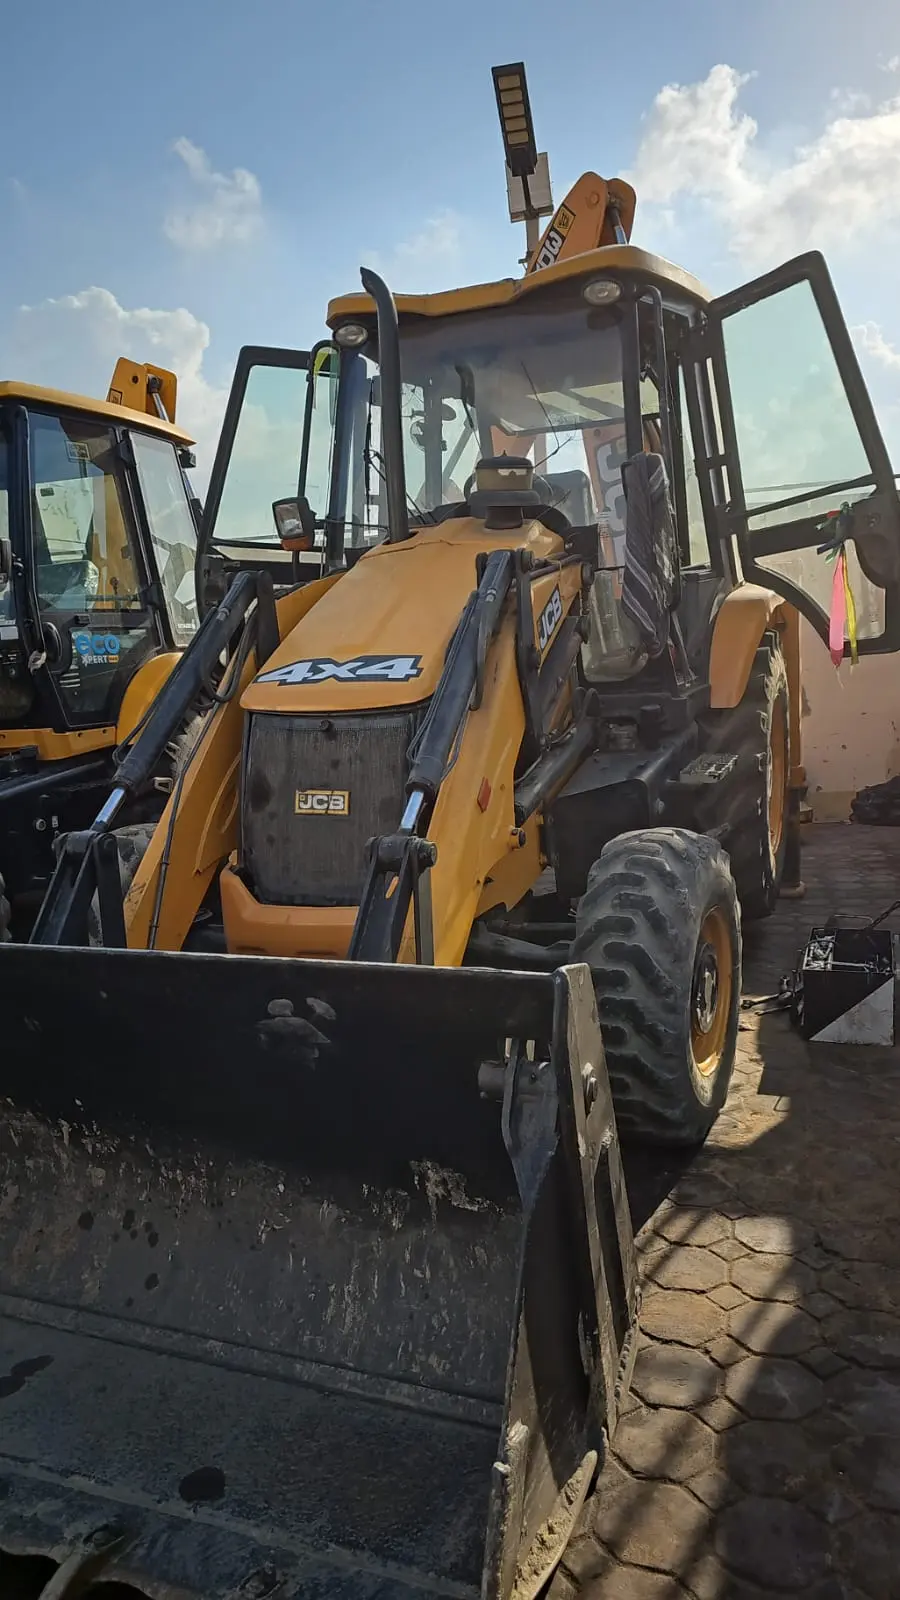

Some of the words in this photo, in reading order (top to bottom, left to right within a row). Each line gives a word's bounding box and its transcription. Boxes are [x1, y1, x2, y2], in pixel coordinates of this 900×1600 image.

[539, 590, 562, 649] JCB
[75, 634, 120, 655] eco
[299, 794, 344, 810] JCB
